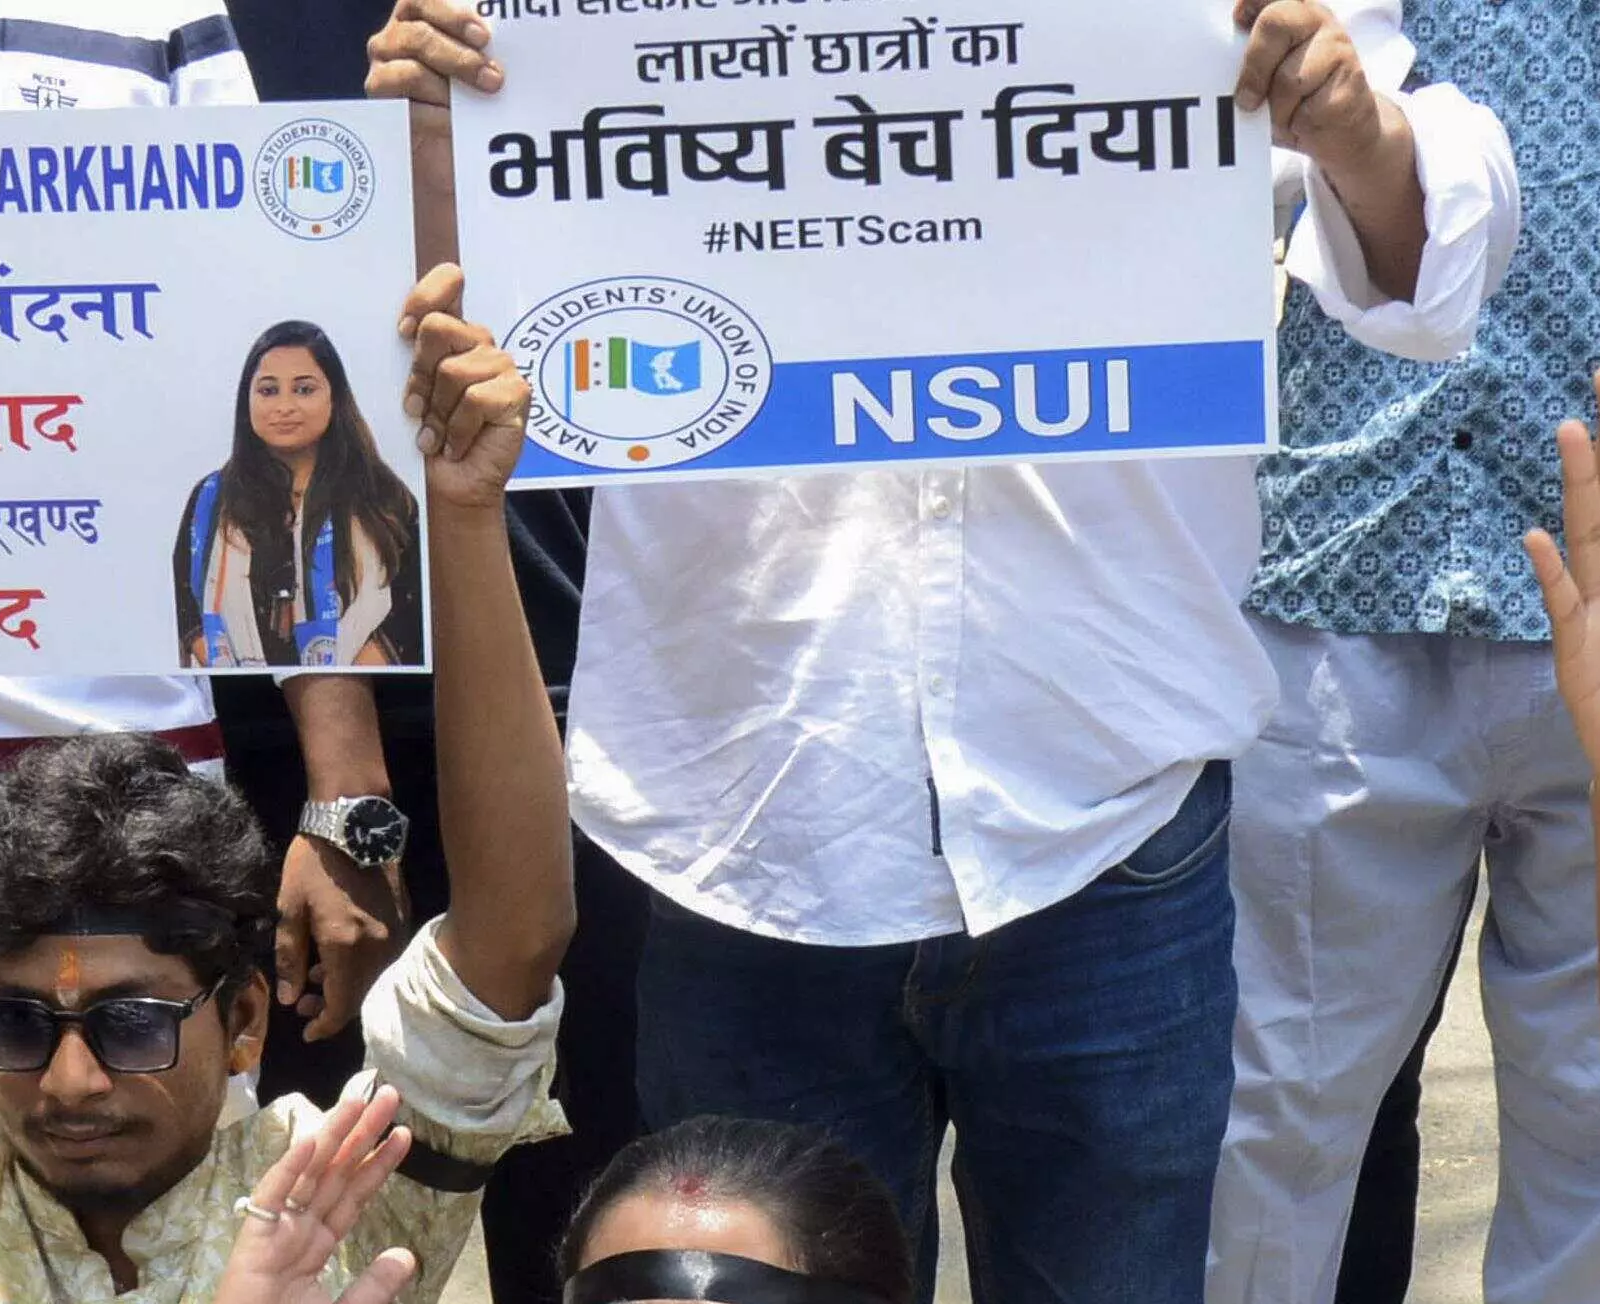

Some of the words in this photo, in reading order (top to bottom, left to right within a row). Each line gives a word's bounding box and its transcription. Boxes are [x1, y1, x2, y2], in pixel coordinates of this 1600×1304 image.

[634, 25, 796, 83] लाखों
[804, 17, 938, 74] छात्रों
[945, 23, 1023, 66] का
[489, 105, 795, 201] भविष्य
[813, 95, 963, 185] बेच
[703, 215, 982, 253] #NEETScam
[682, 296, 755, 357] UNION
[516, 359, 598, 455] NATIOL
[735, 363, 758, 395] OF
[830, 357, 1133, 447] NSUI
[677, 398, 748, 449] INDIA
